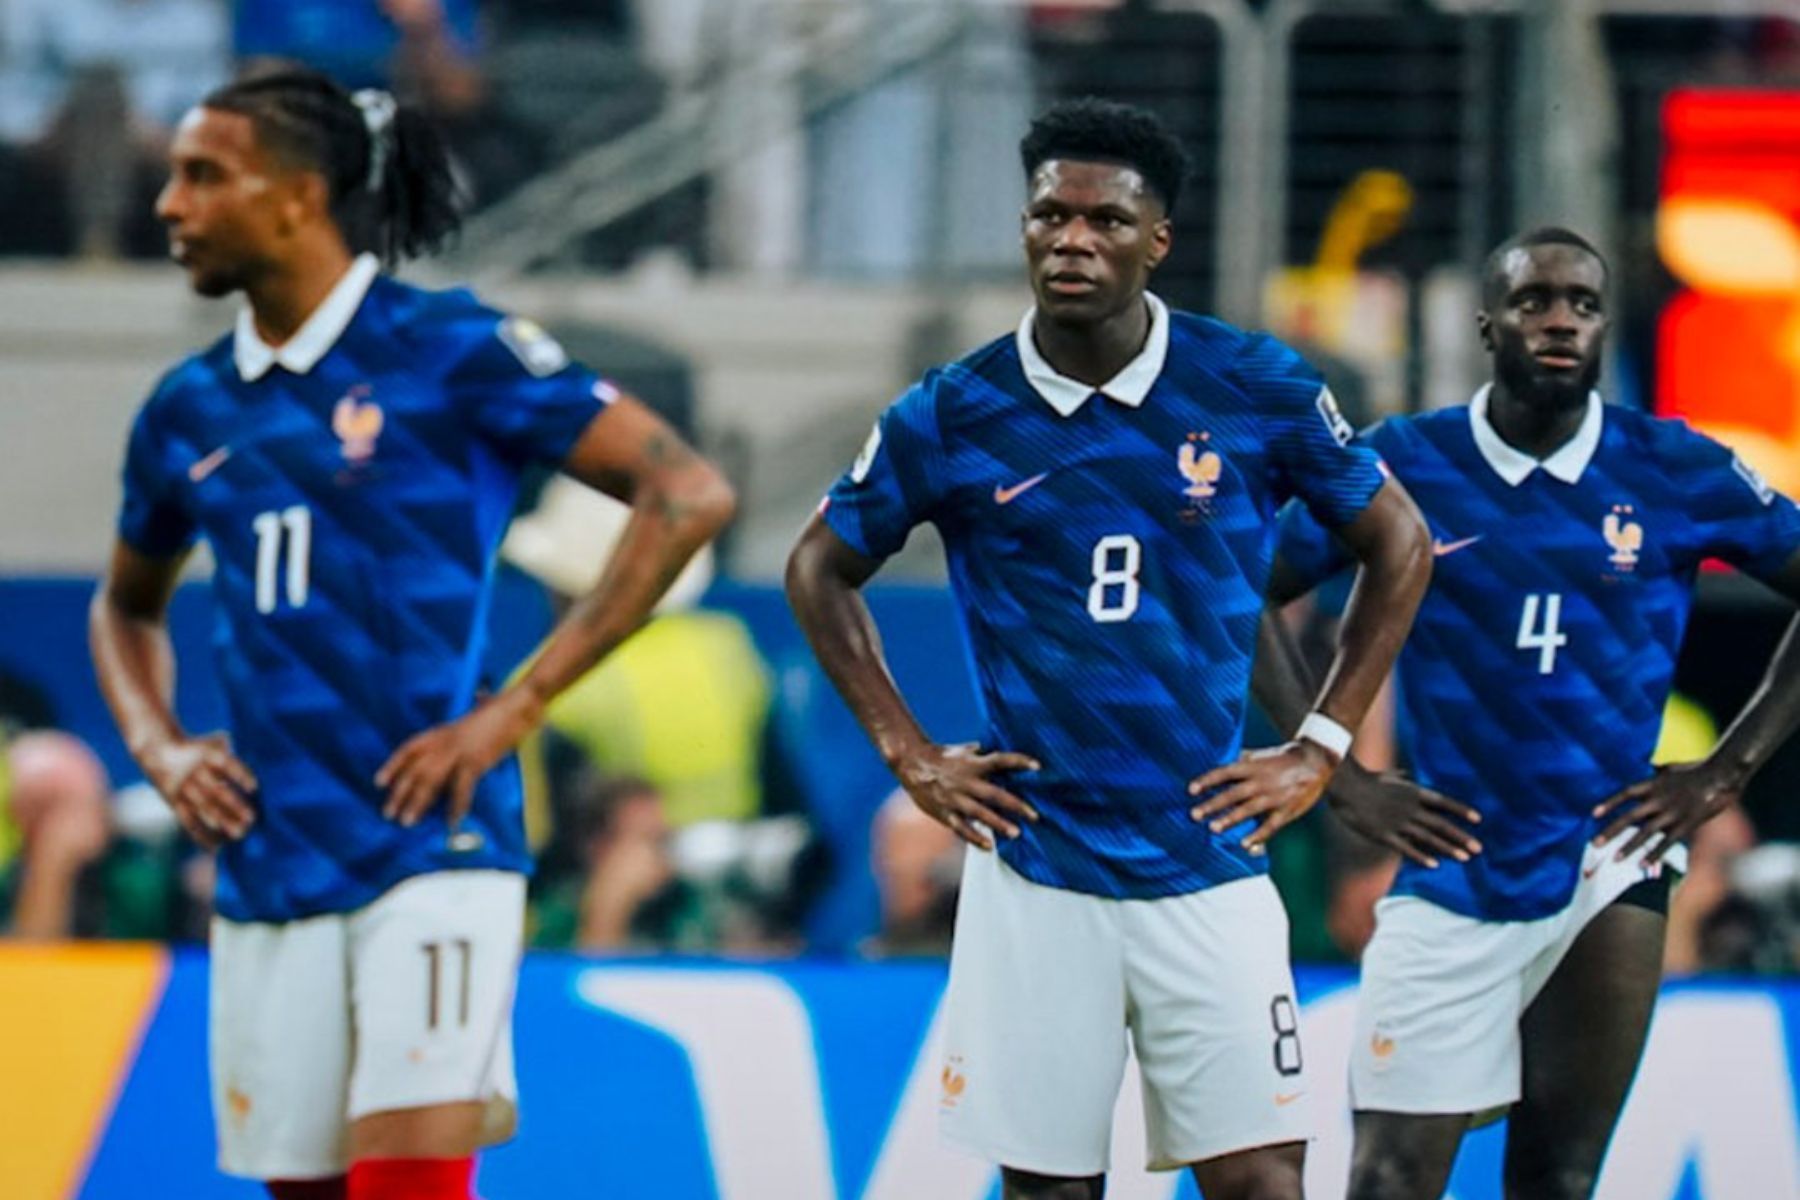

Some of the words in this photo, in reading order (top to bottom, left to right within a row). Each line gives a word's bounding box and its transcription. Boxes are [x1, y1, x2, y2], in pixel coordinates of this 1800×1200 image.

[253, 505, 311, 614] 11
[1087, 533, 1140, 622] 8
[1516, 593, 1567, 674] 4
[419, 938, 471, 1028] 11
[1270, 995, 1303, 1076] 8
